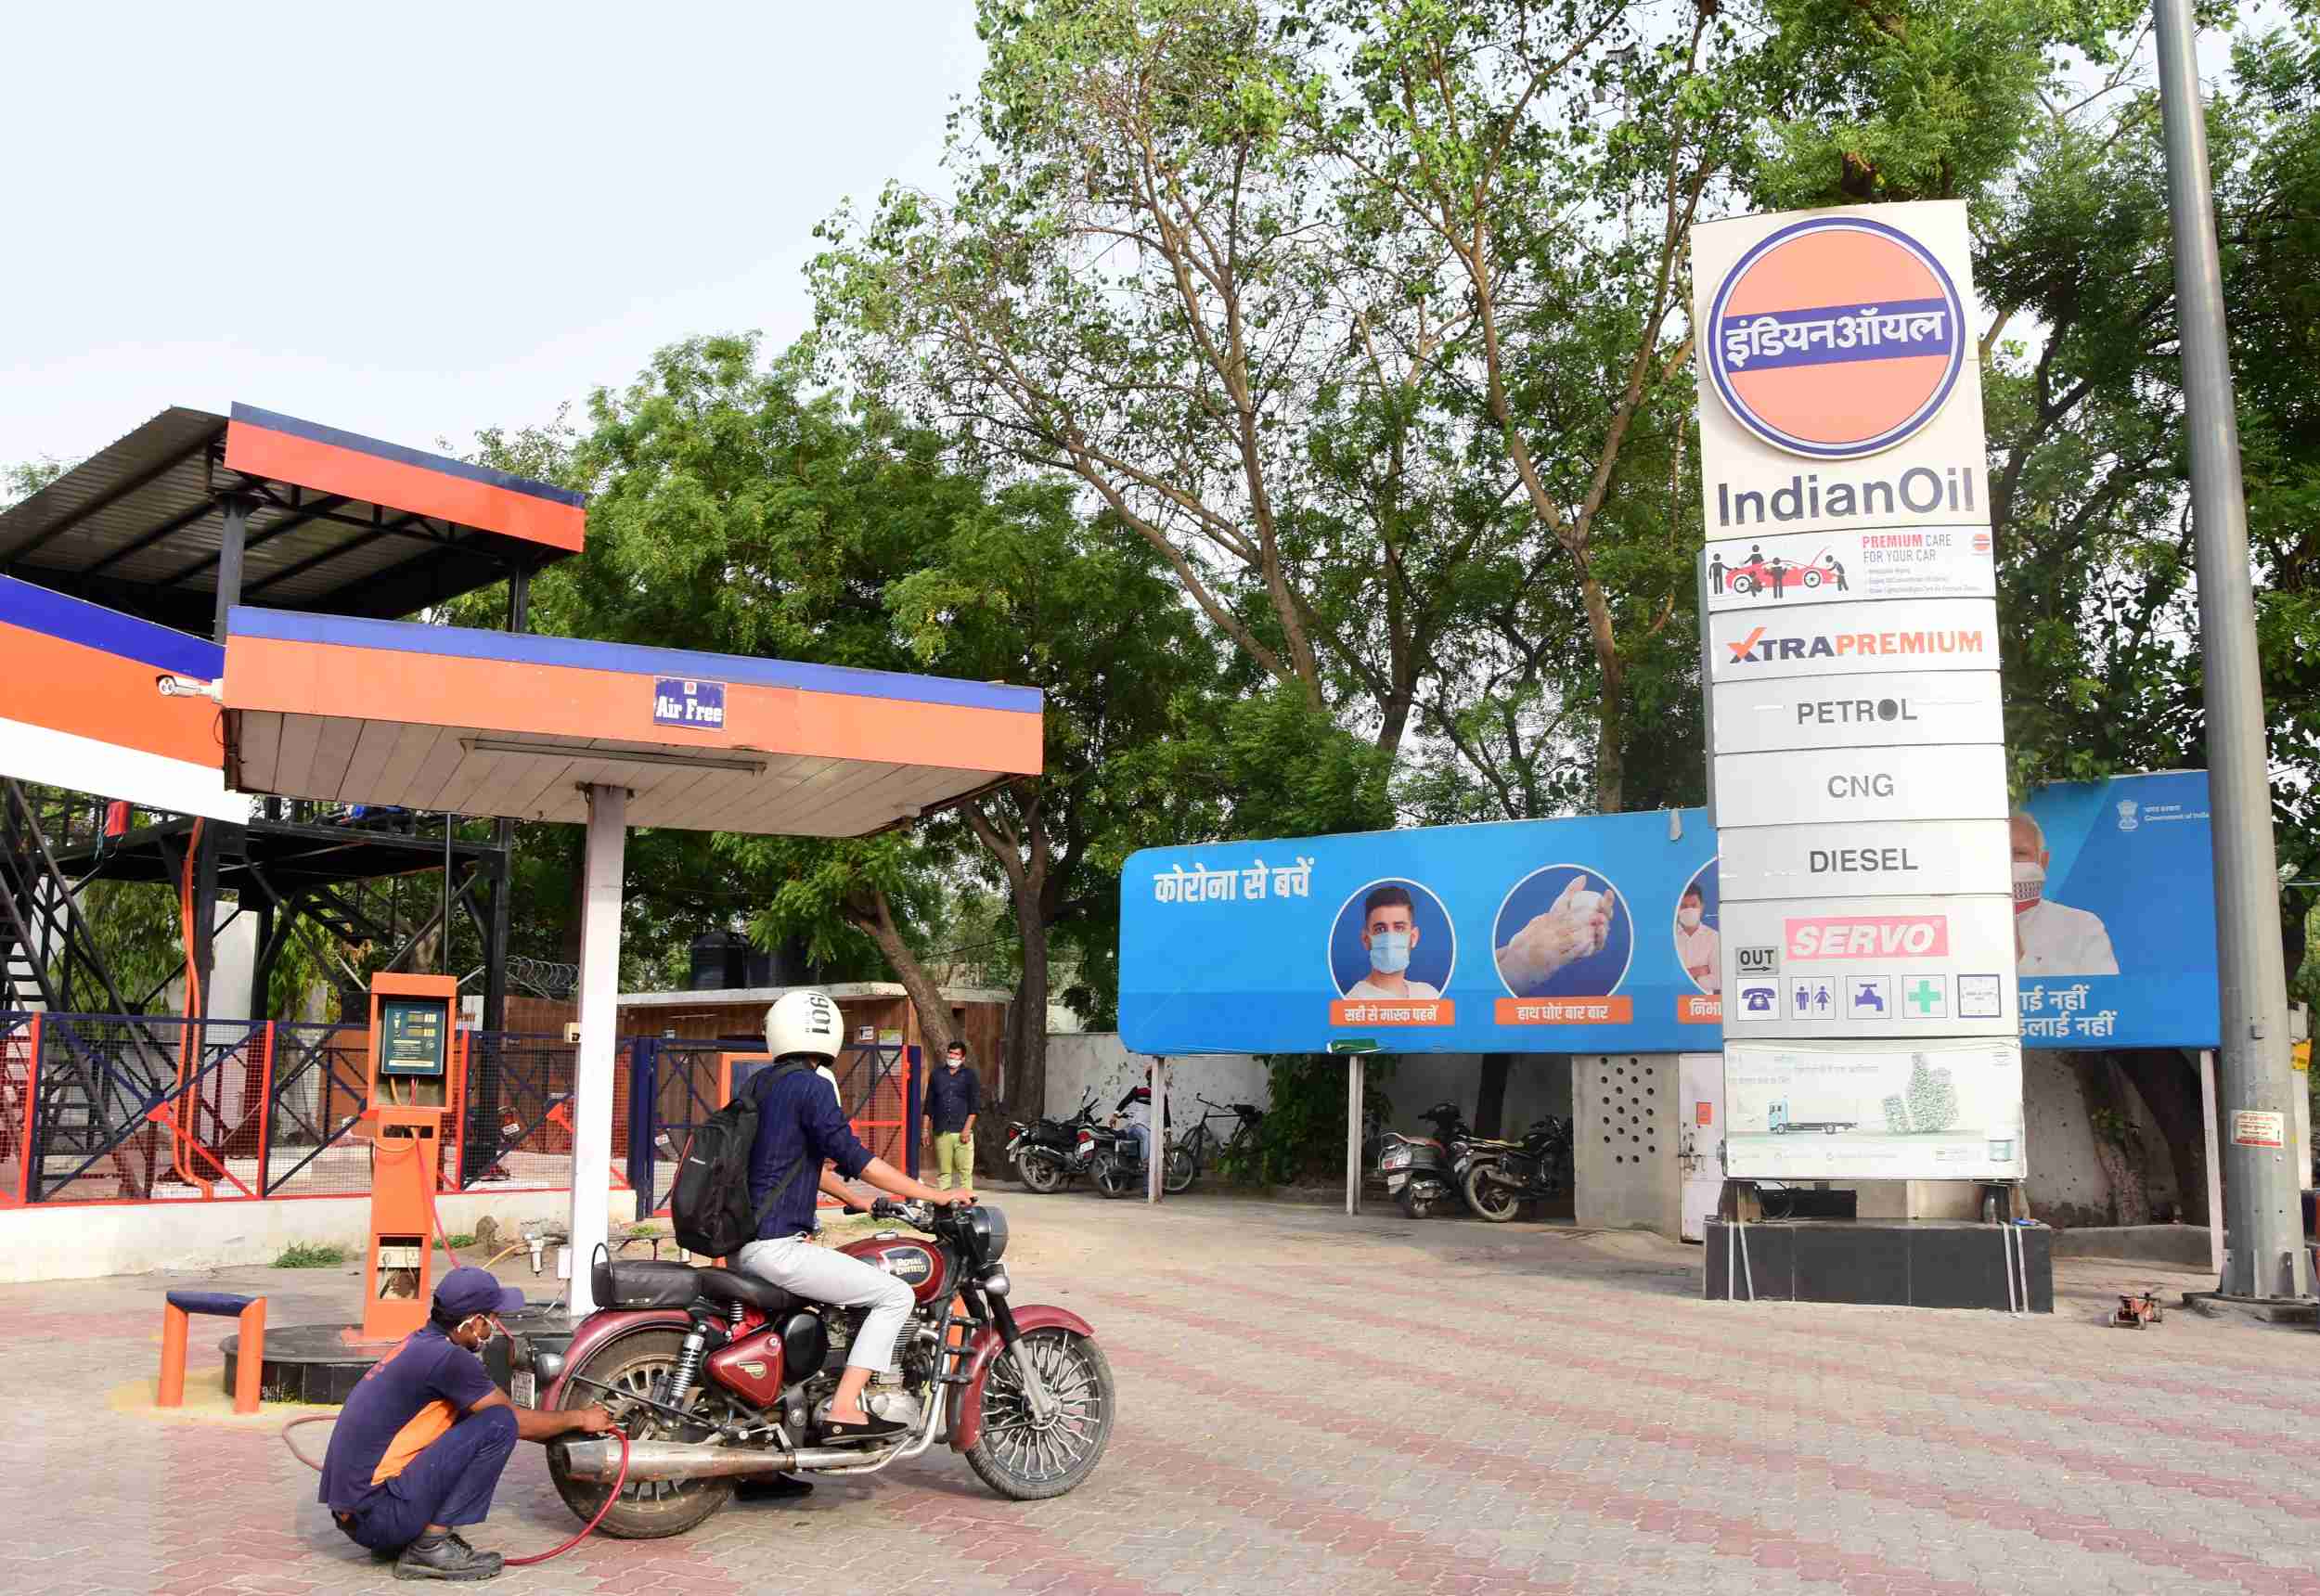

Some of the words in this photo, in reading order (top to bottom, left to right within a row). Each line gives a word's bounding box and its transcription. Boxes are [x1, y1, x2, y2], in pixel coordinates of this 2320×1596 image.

[1724, 307, 1946, 368] इंडियनऑयल
[1717, 467, 1976, 527] IndianOil
[1862, 534, 1924, 549] PREMIUM
[1925, 534, 1953, 547] CARE
[1862, 550, 1884, 564] FOR
[1886, 550, 1914, 562] YOUR
[1915, 549, 1937, 561] CAR
[655, 695, 683, 719] Air
[685, 698, 723, 723] Free
[1797, 698, 1918, 725] PETROL
[1826, 773, 1895, 799] CNG
[1810, 848, 1918, 873] DIESEL
[1154, 863, 1239, 903] कोरोना
[1242, 859, 1270, 899] से
[1272, 856, 1315, 897] बचें
[1790, 922, 1936, 956] SERVO
[1739, 949, 1775, 966] OUT
[1689, 998, 1722, 1016] निभा
[2047, 984, 2091, 1010] नहीं
[2074, 1010, 2118, 1036] नहीं
